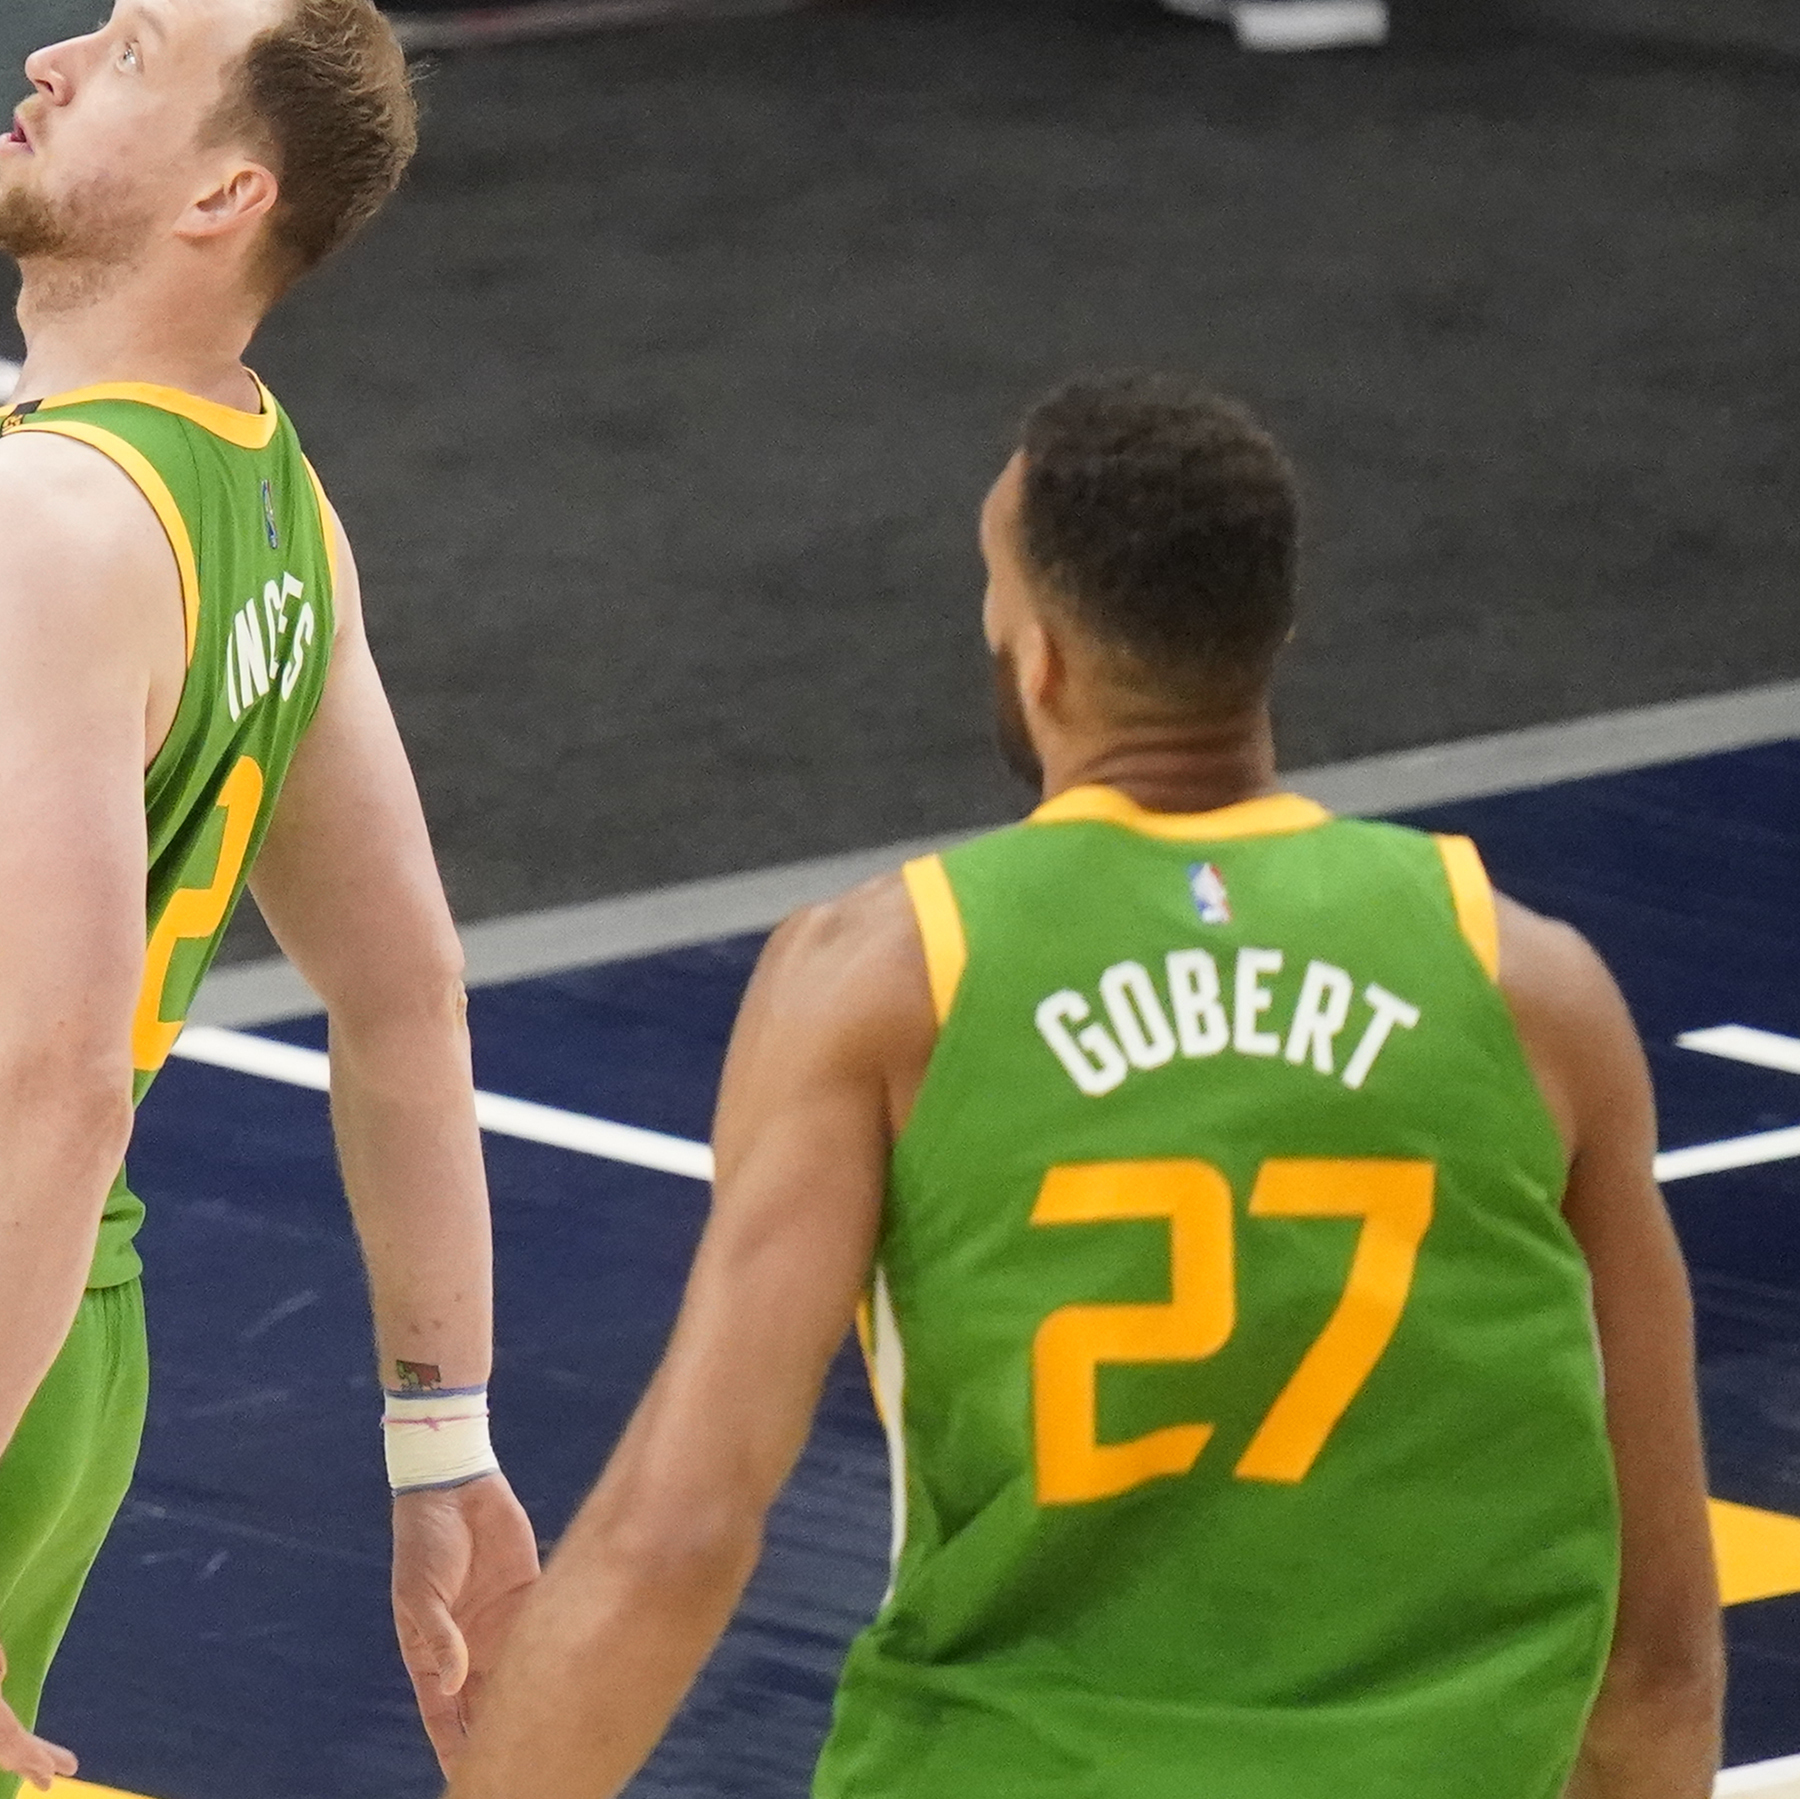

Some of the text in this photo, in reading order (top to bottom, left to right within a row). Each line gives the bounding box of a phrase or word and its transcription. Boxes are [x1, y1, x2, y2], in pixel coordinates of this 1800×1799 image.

[131, 754, 263, 1071] 2
[1034, 946, 1421, 1096] GOBERT
[1029, 1156, 1437, 1503] 27
